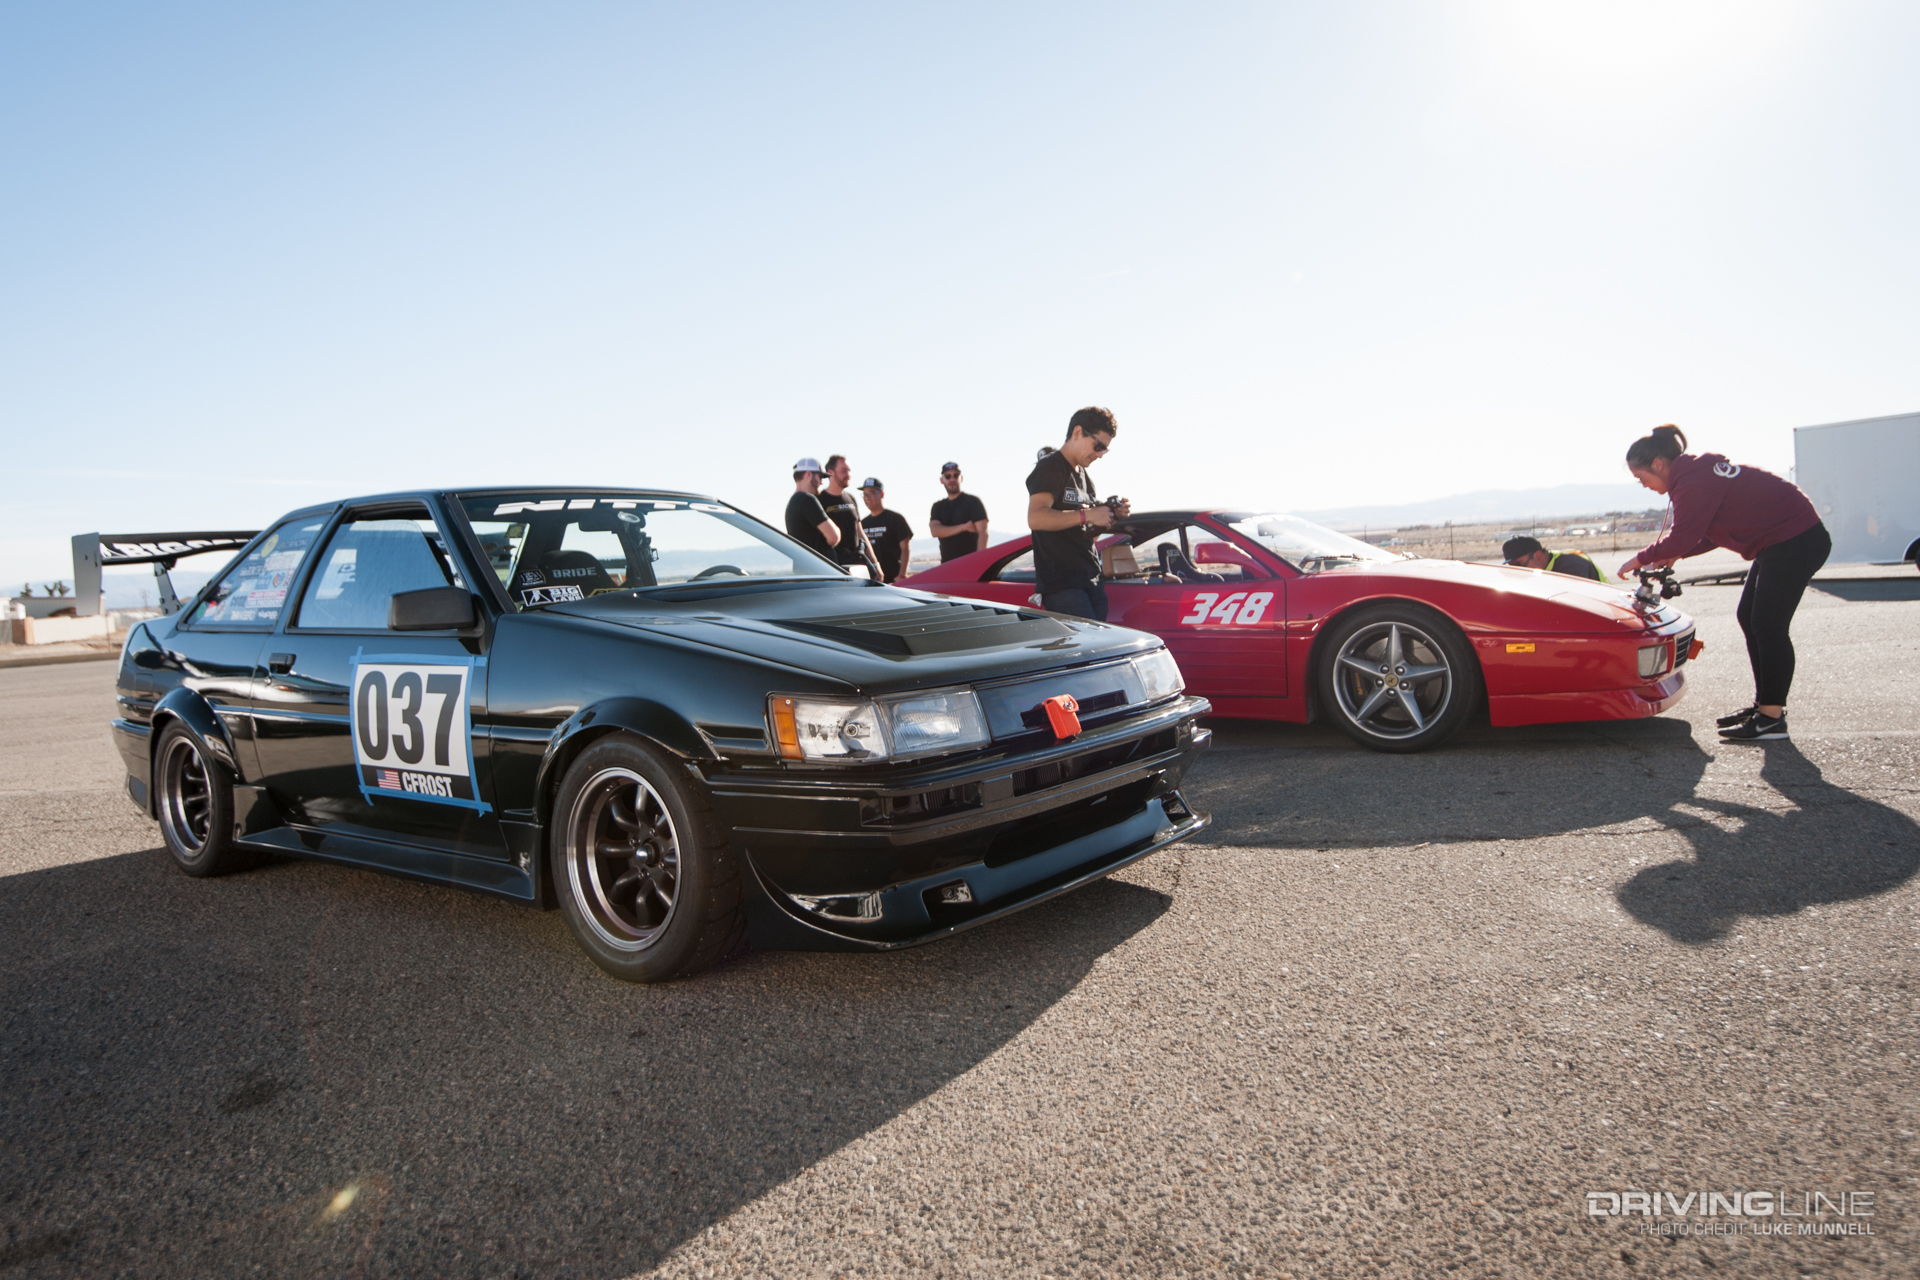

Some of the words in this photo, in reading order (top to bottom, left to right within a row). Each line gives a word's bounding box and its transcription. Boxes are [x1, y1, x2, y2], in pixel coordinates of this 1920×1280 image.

[493, 499, 737, 516] NITTO
[552, 567, 597, 578] BRIDE
[548, 587, 579, 595] BIG
[1181, 591, 1274, 625] 348
[357, 670, 462, 767] 037
[402, 772, 453, 797] CFROST
